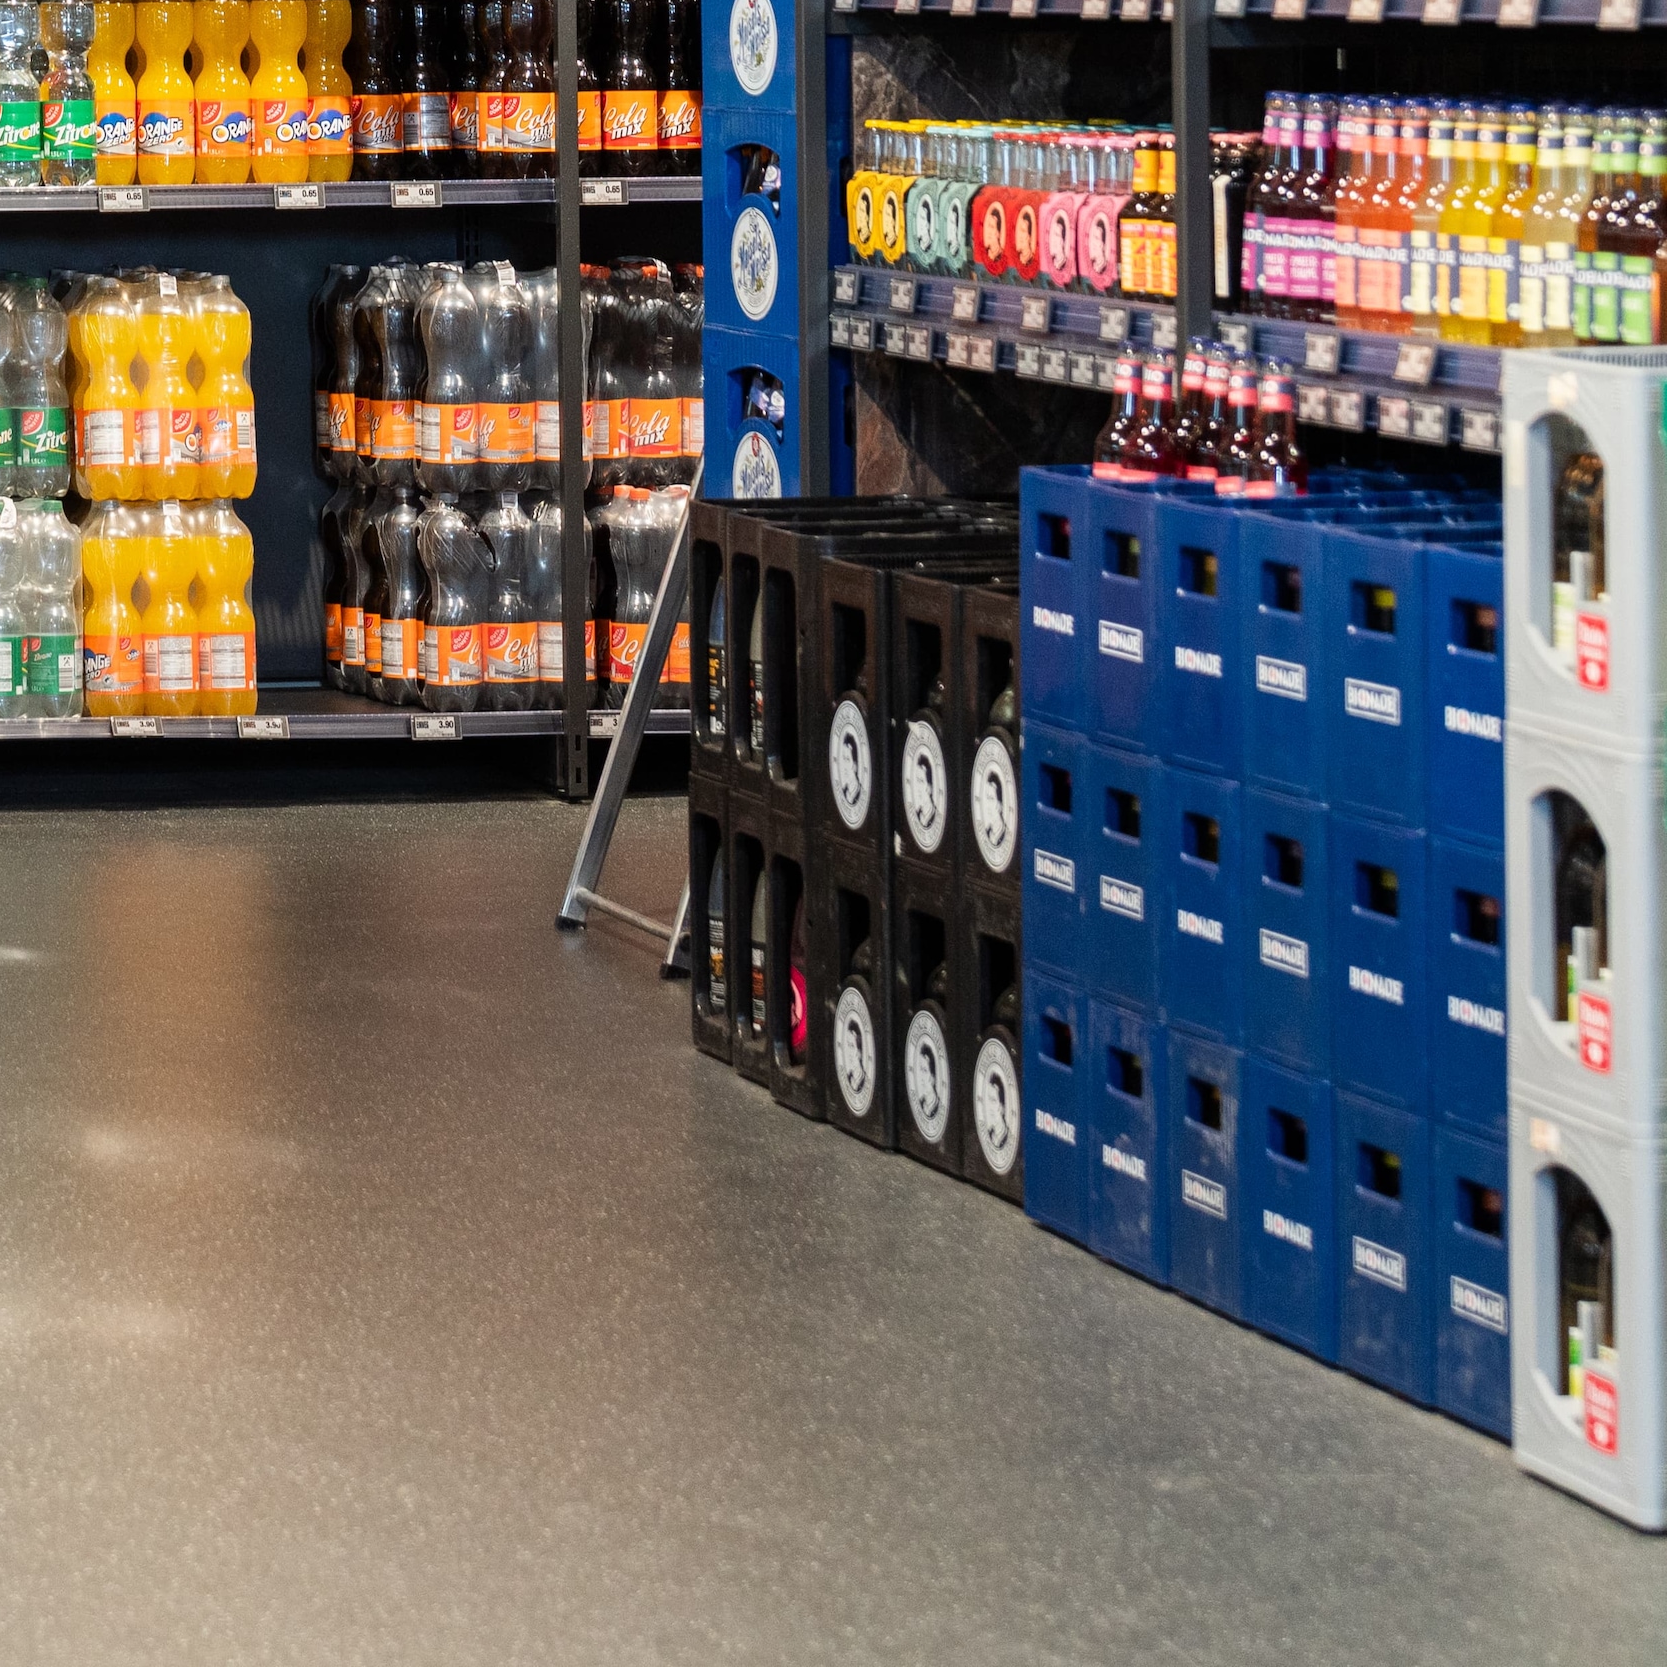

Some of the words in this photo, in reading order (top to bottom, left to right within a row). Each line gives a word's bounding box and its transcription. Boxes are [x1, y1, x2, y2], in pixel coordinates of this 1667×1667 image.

[359, 105, 400, 133] Cola
[604, 101, 646, 130] Cola
[657, 102, 695, 129] Cola
[138, 117, 183, 142] ORANGE
[611, 122, 642, 140] mix
[662, 121, 691, 138] mix
[107, 133, 131, 147] ZERO
[146, 133, 173, 147] ZERO
[126, 193, 142, 201] 0.65
[302, 189, 317, 198] 0.65
[418, 187, 434, 196] 0.65
[605, 185, 621, 194] 0.65
[629, 410, 670, 437] Cola
[633, 430, 664, 447] mix
[139, 720, 155, 729] 3.90
[438, 719, 454, 729] 3.90
